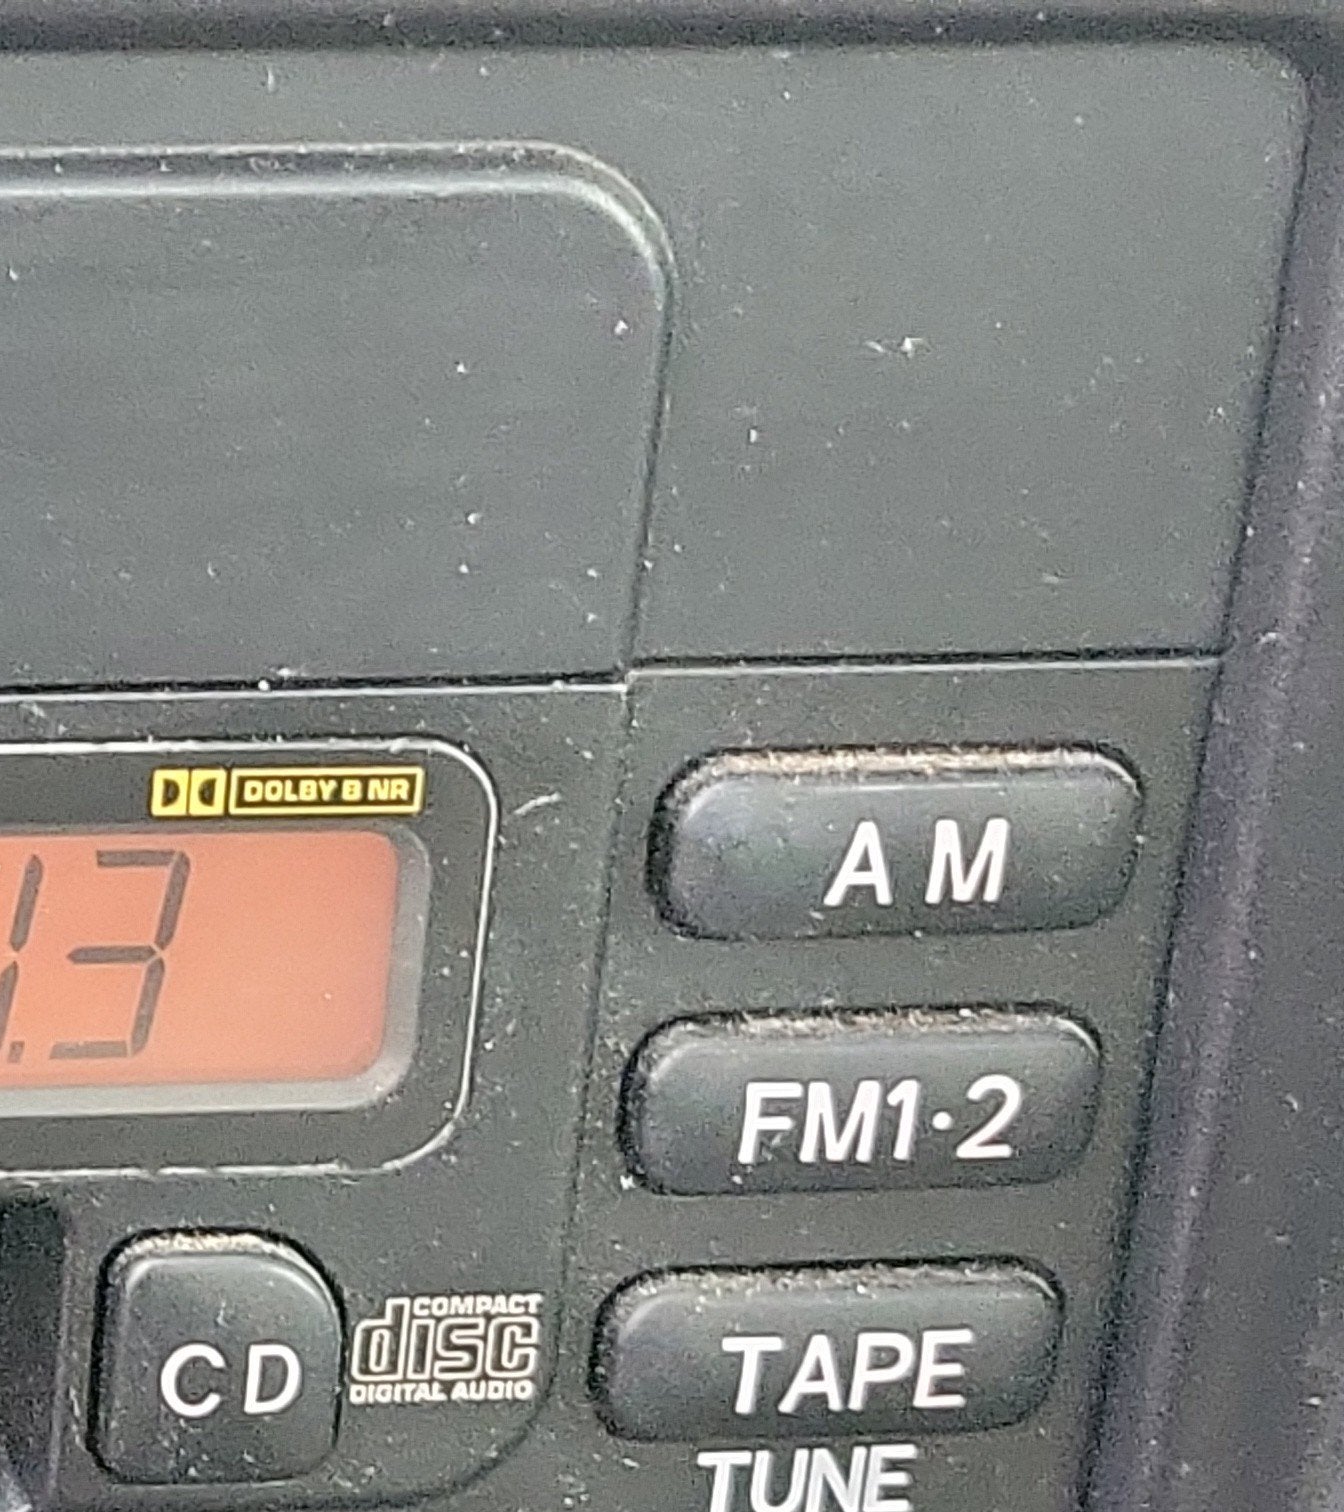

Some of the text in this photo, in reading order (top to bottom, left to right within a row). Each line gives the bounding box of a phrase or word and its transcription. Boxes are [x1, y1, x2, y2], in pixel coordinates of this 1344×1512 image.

[243, 778, 410, 802] DOLBY B NR
[413, 1293, 542, 1316] COMPACT
[722, 1328, 973, 1415] TAPE
[349, 1379, 534, 1405] DIGITAL AUDIO
